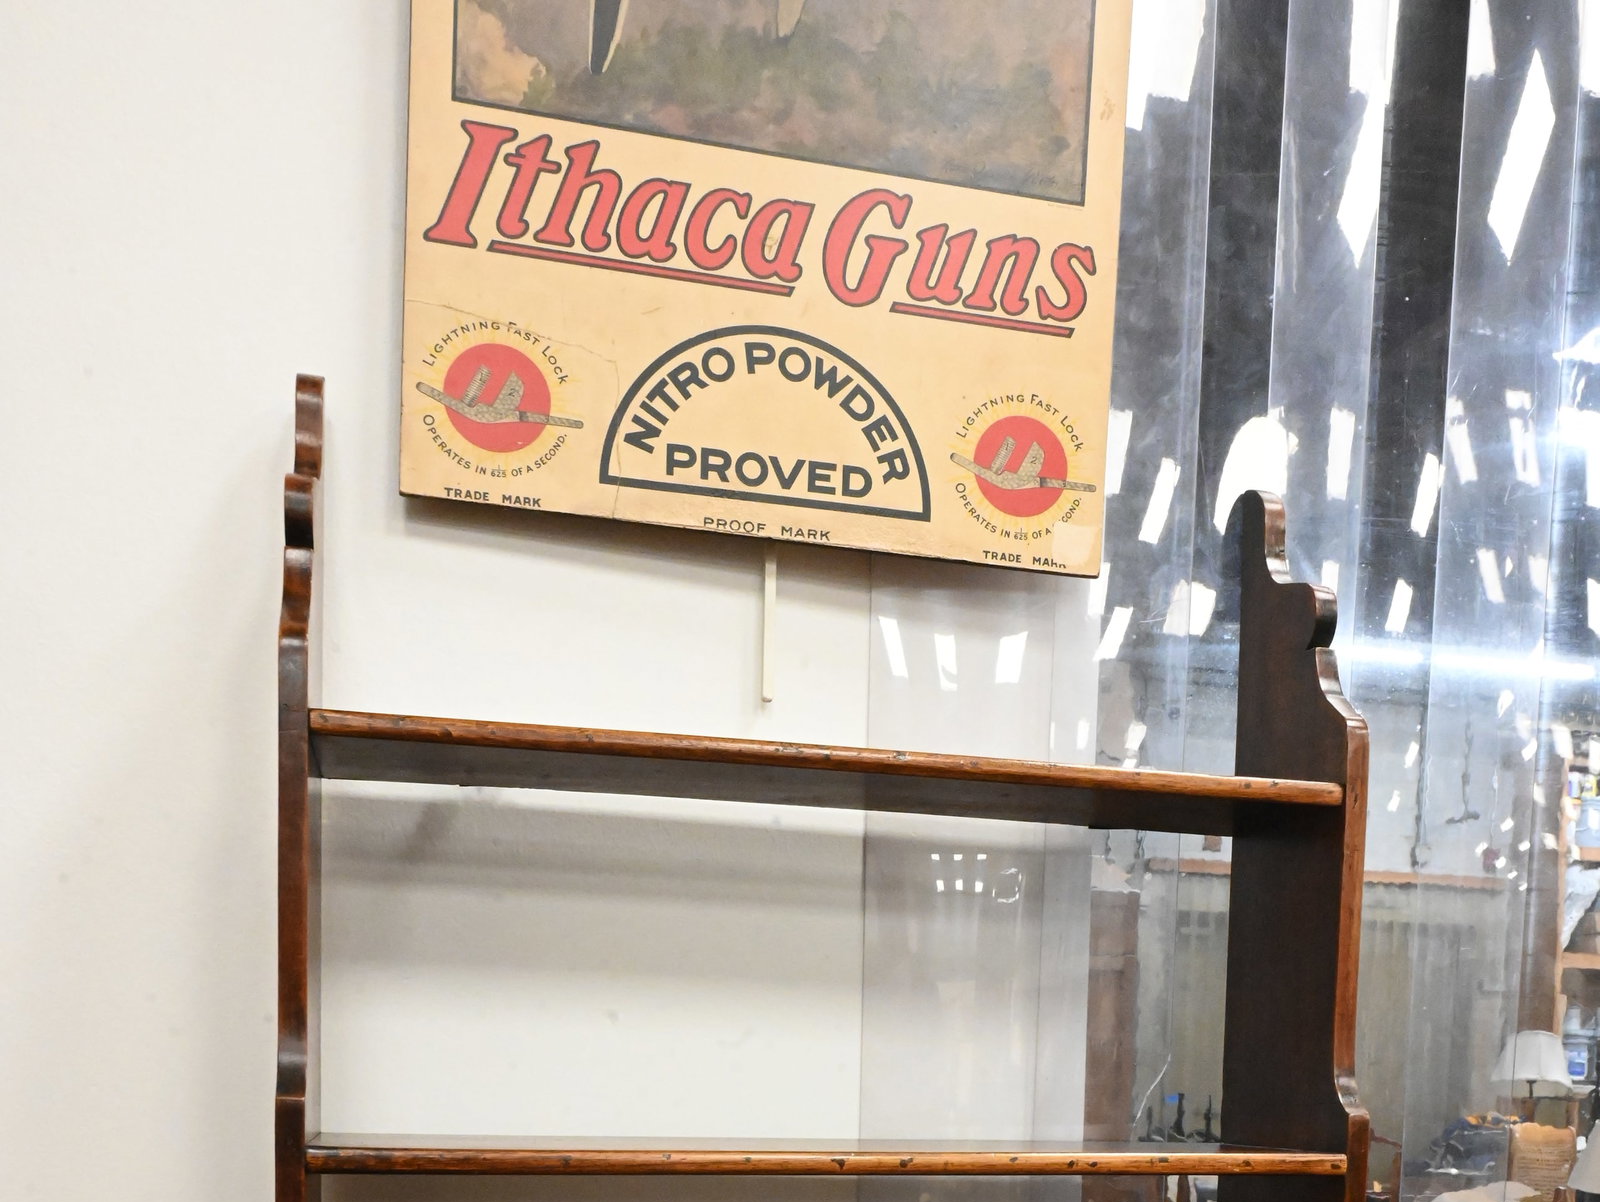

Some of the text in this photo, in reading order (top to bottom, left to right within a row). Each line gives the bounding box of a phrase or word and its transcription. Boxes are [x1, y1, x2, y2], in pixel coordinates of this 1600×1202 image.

[423, 119, 1096, 322] Ithaca Guns
[422, 321, 569, 384] LIGHTNING FAST LOCK
[623, 341, 910, 484] NITRO POWDER
[956, 394, 1084, 452] LIGHTNING FAST LOCK
[423, 414, 471, 469] OPERATES
[475, 465, 487, 476] IN
[511, 467, 523, 477] OF
[526, 465, 534, 473] A
[534, 433, 567, 469] SECOND.
[666, 443, 873, 498] PROVED
[444, 487, 541, 507] TRADE MARK
[955, 482, 996, 533] OPERATES
[1000, 529, 1011, 538] IN
[1031, 530, 1042, 539] OF
[1045, 527, 1052, 536] A
[1052, 497, 1082, 527] COND.
[703, 517, 831, 542] PROOF MARK
[982, 550, 1022, 563] TRADE
